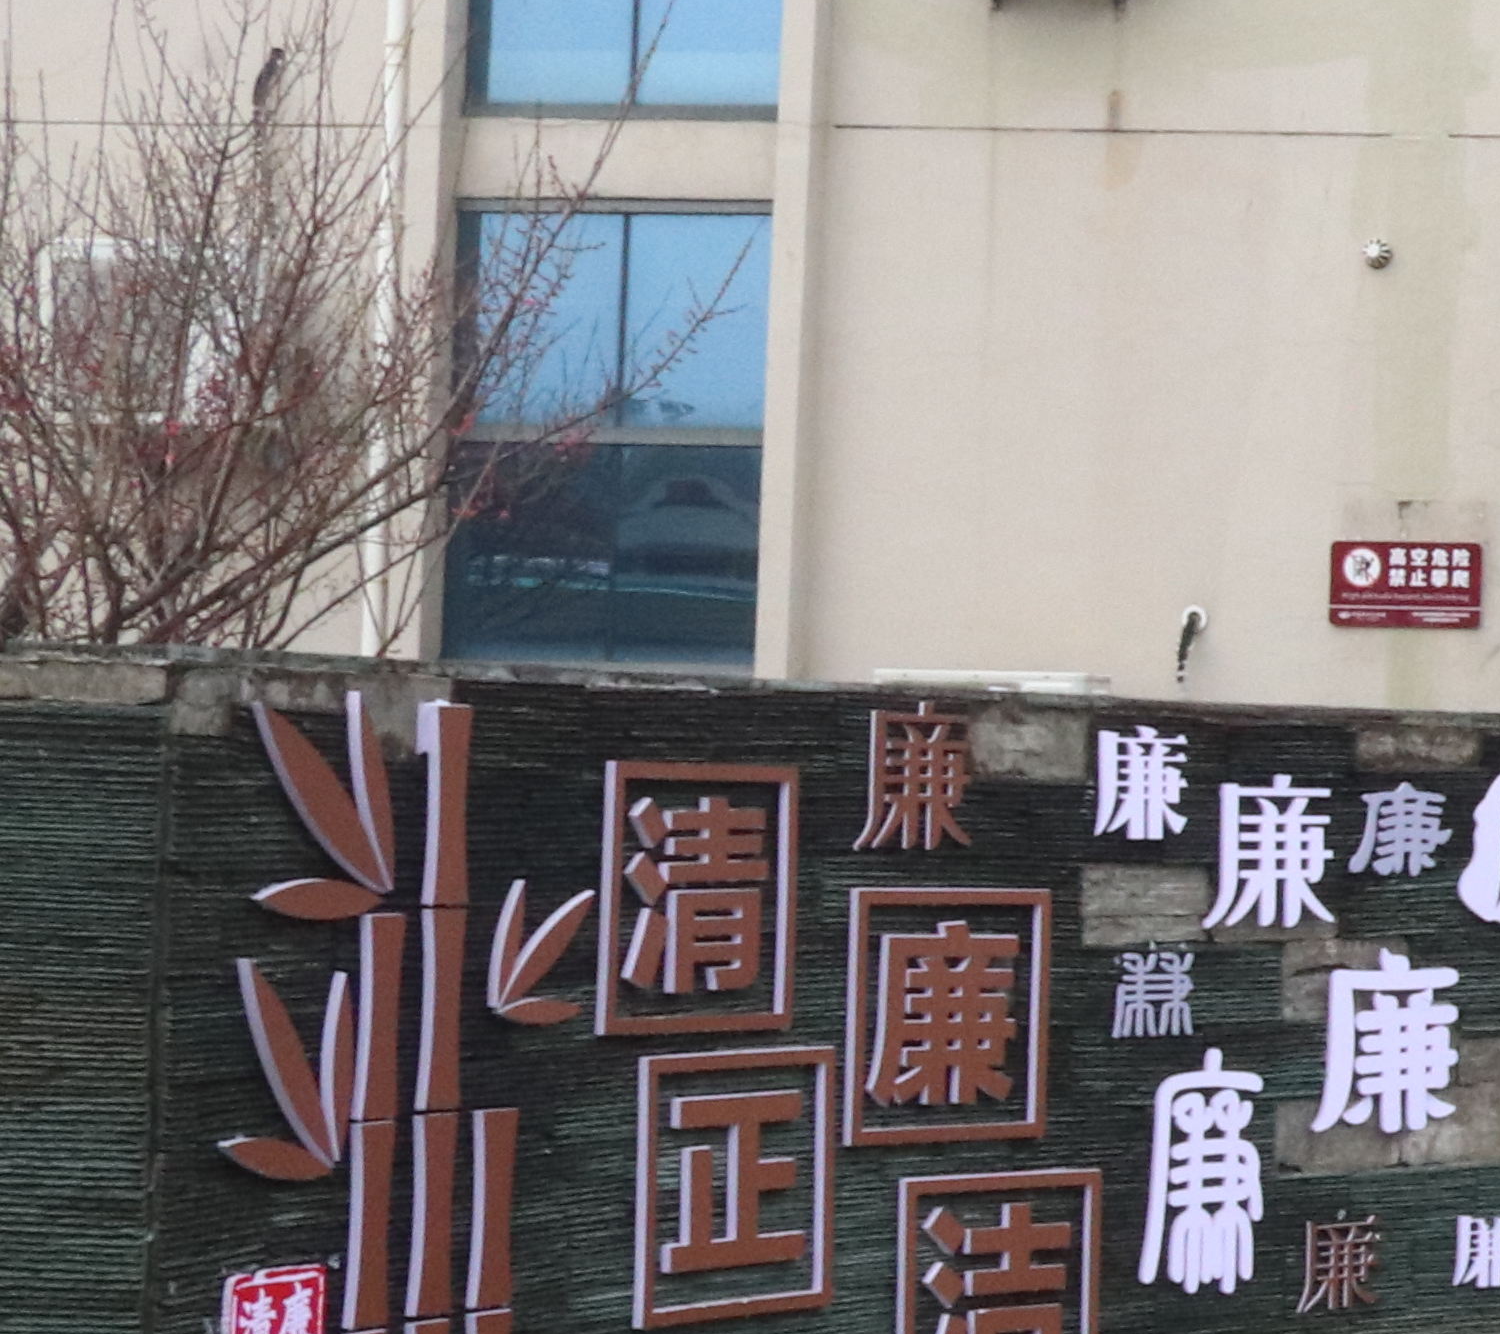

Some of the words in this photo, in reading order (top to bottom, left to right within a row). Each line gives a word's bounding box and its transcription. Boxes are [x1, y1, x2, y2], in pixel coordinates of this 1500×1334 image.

[853, 703, 972, 850] 廉
[1094, 725, 1188, 840] 廉
[1348, 781, 1453, 876] 廉
[1202, 774, 1336, 929] 廉
[1311, 947, 1460, 1133] 廉
[1297, 1210, 1381, 1313] 廉
